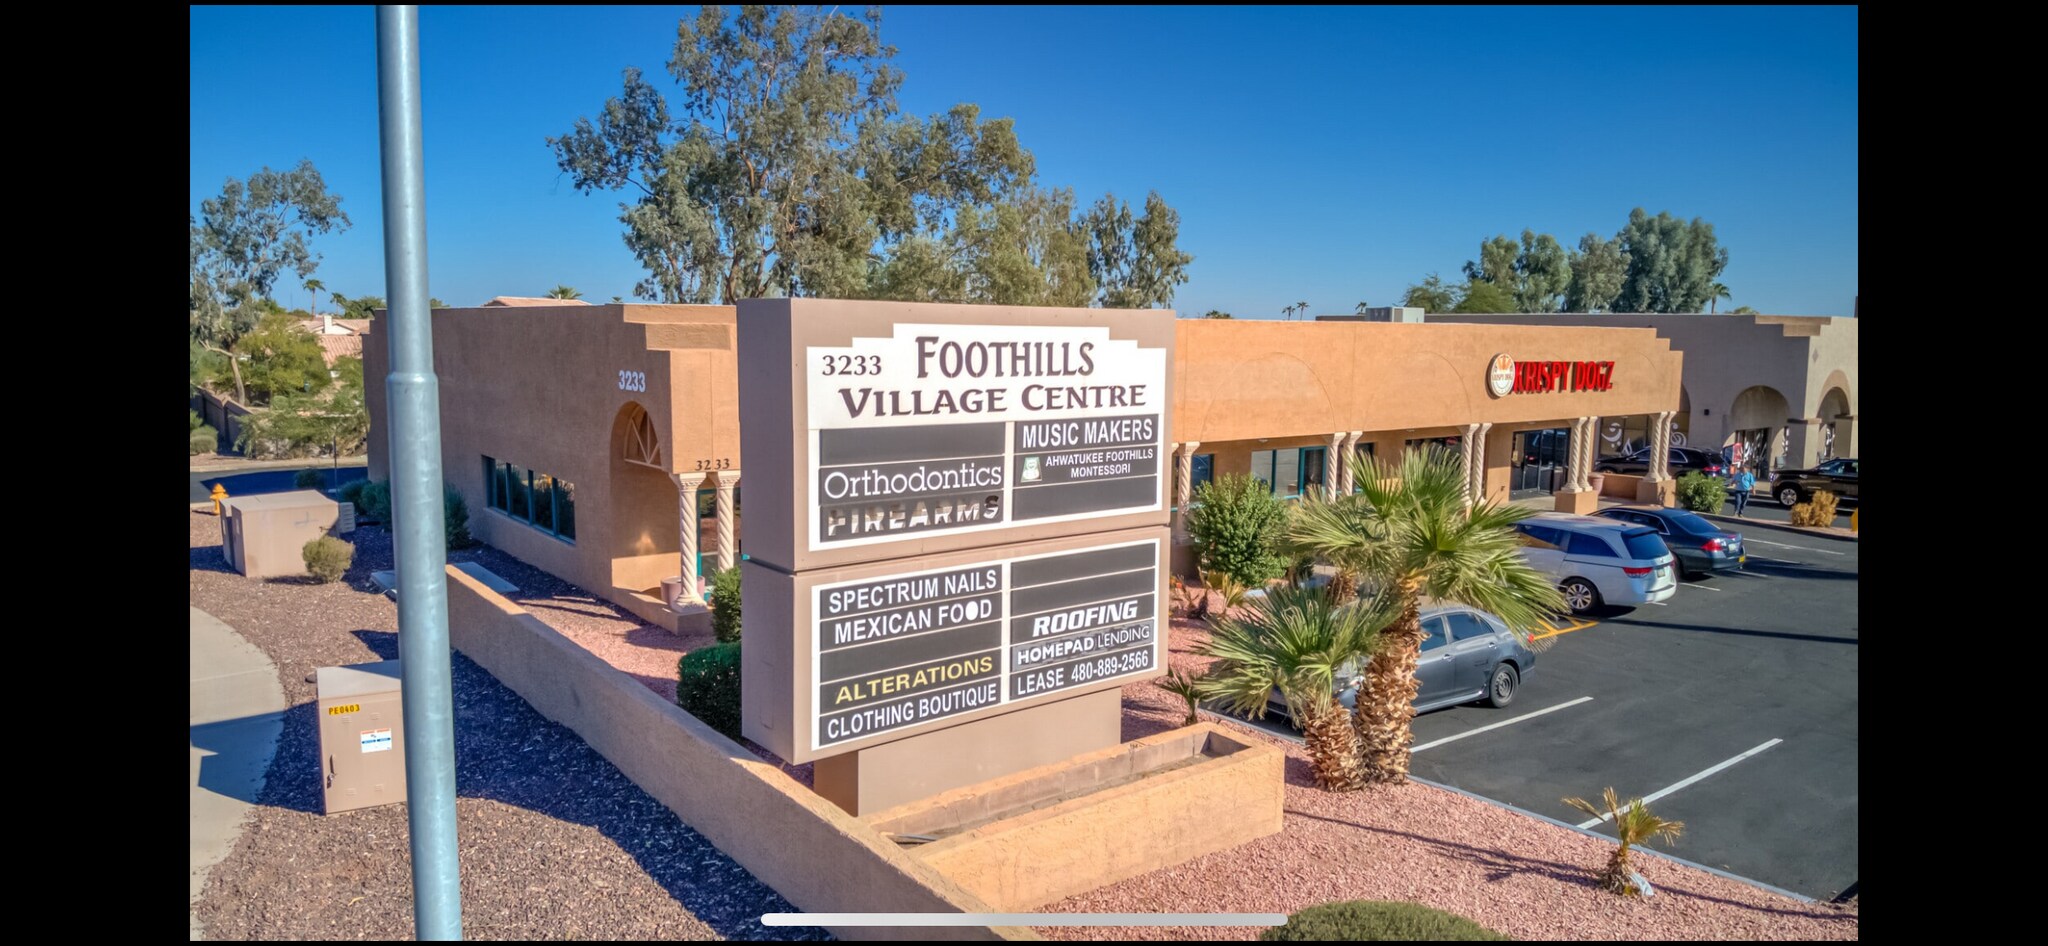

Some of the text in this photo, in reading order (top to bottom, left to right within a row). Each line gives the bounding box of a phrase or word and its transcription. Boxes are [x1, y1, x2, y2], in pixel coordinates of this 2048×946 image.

[822, 355, 882, 375] 3233
[916, 336, 1094, 378] FOOTHILLS
[619, 370, 646, 392] 3233
[1513, 361, 1615, 392] KRISPY DOGZ
[839, 384, 1147, 418] VILLAGE CENTRE
[1022, 419, 1153, 449] MUSIC MAKERS
[695, 459, 730, 471] 3233
[1045, 448, 1153, 466] AHWATUKEE FOOTHILLS
[1070, 464, 1130, 478] MONTESSORI
[825, 463, 1002, 499] Orthodontics
[828, 495, 1000, 536] FIREARMS
[828, 569, 997, 614] SPECTRUM NAILS
[834, 599, 992, 644] MEXICAN FOOD
[1032, 599, 1139, 637] ROOFING
[1017, 624, 1150, 665] HOMEPAD LENDING
[835, 656, 993, 704] ALTERATIONS
[1017, 650, 1149, 696] LEASE 480-889-2566
[827, 683, 997, 740] CLOTHING BOUTIQUE
